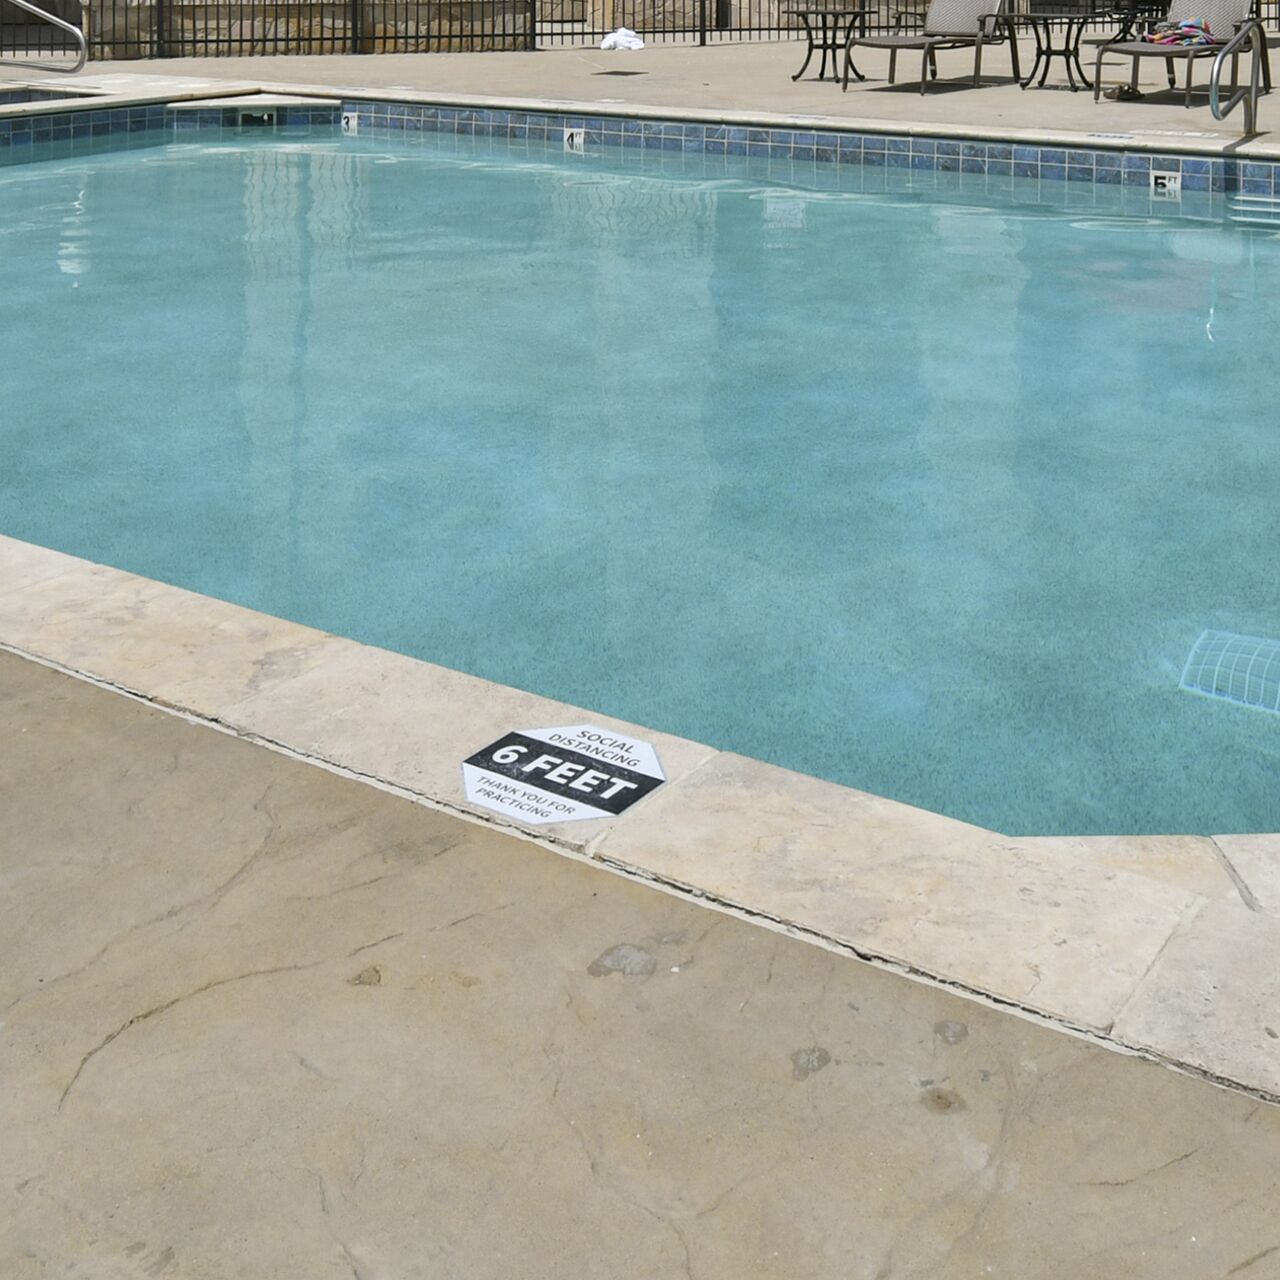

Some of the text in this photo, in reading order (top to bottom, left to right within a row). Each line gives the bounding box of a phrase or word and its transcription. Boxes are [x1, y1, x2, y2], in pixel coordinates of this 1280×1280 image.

[1154, 175, 1167, 188] 5
[548, 733, 641, 767] DISTANCING
[576, 730, 634, 754] SOCIAL
[492, 745, 638, 799] 6 FEET
[475, 787, 552, 818] PRACTICING
[477, 776, 576, 814] THANK YOU FOR
